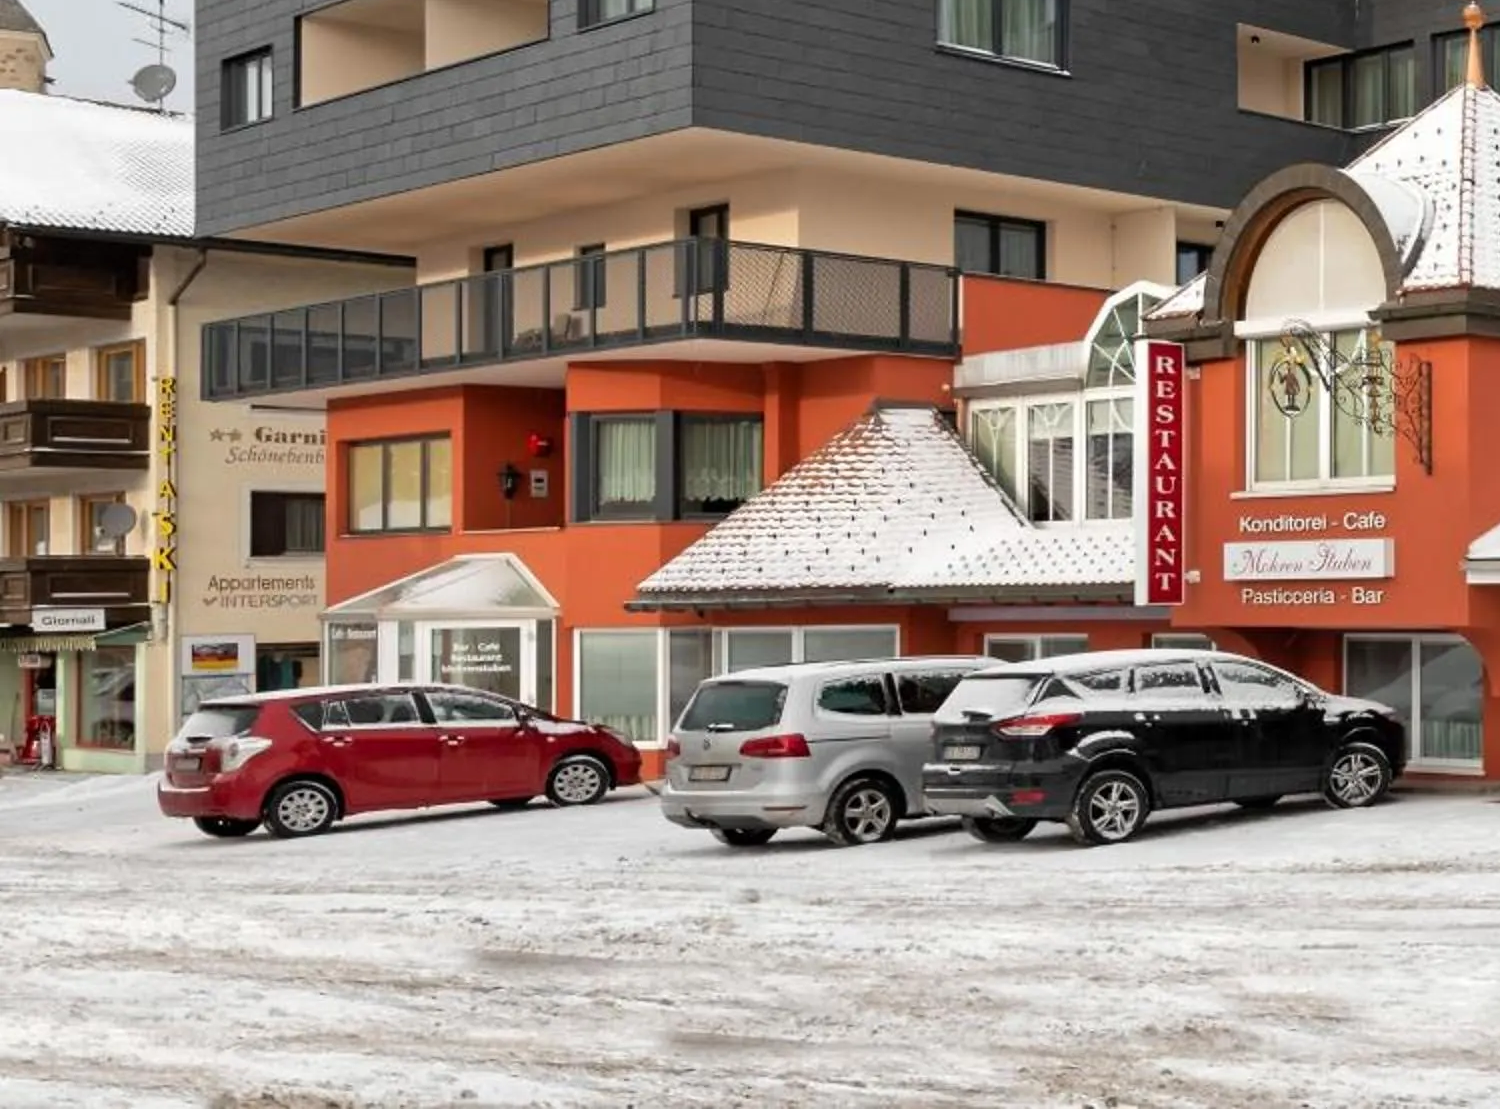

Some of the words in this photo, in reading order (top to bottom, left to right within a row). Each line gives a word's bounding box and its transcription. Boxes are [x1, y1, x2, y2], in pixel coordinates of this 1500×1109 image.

[254, 426, 326, 445] Garni
[1154, 355, 1177, 592] RESTAURANT
[1239, 514, 1327, 533] Konditorei
[1343, 510, 1386, 530] Cafe
[207, 574, 316, 592] Appartements
[220, 594, 318, 609] INTERSPORT
[1241, 587, 1335, 604] Pasticceria
[1352, 586, 1385, 604] Bar
